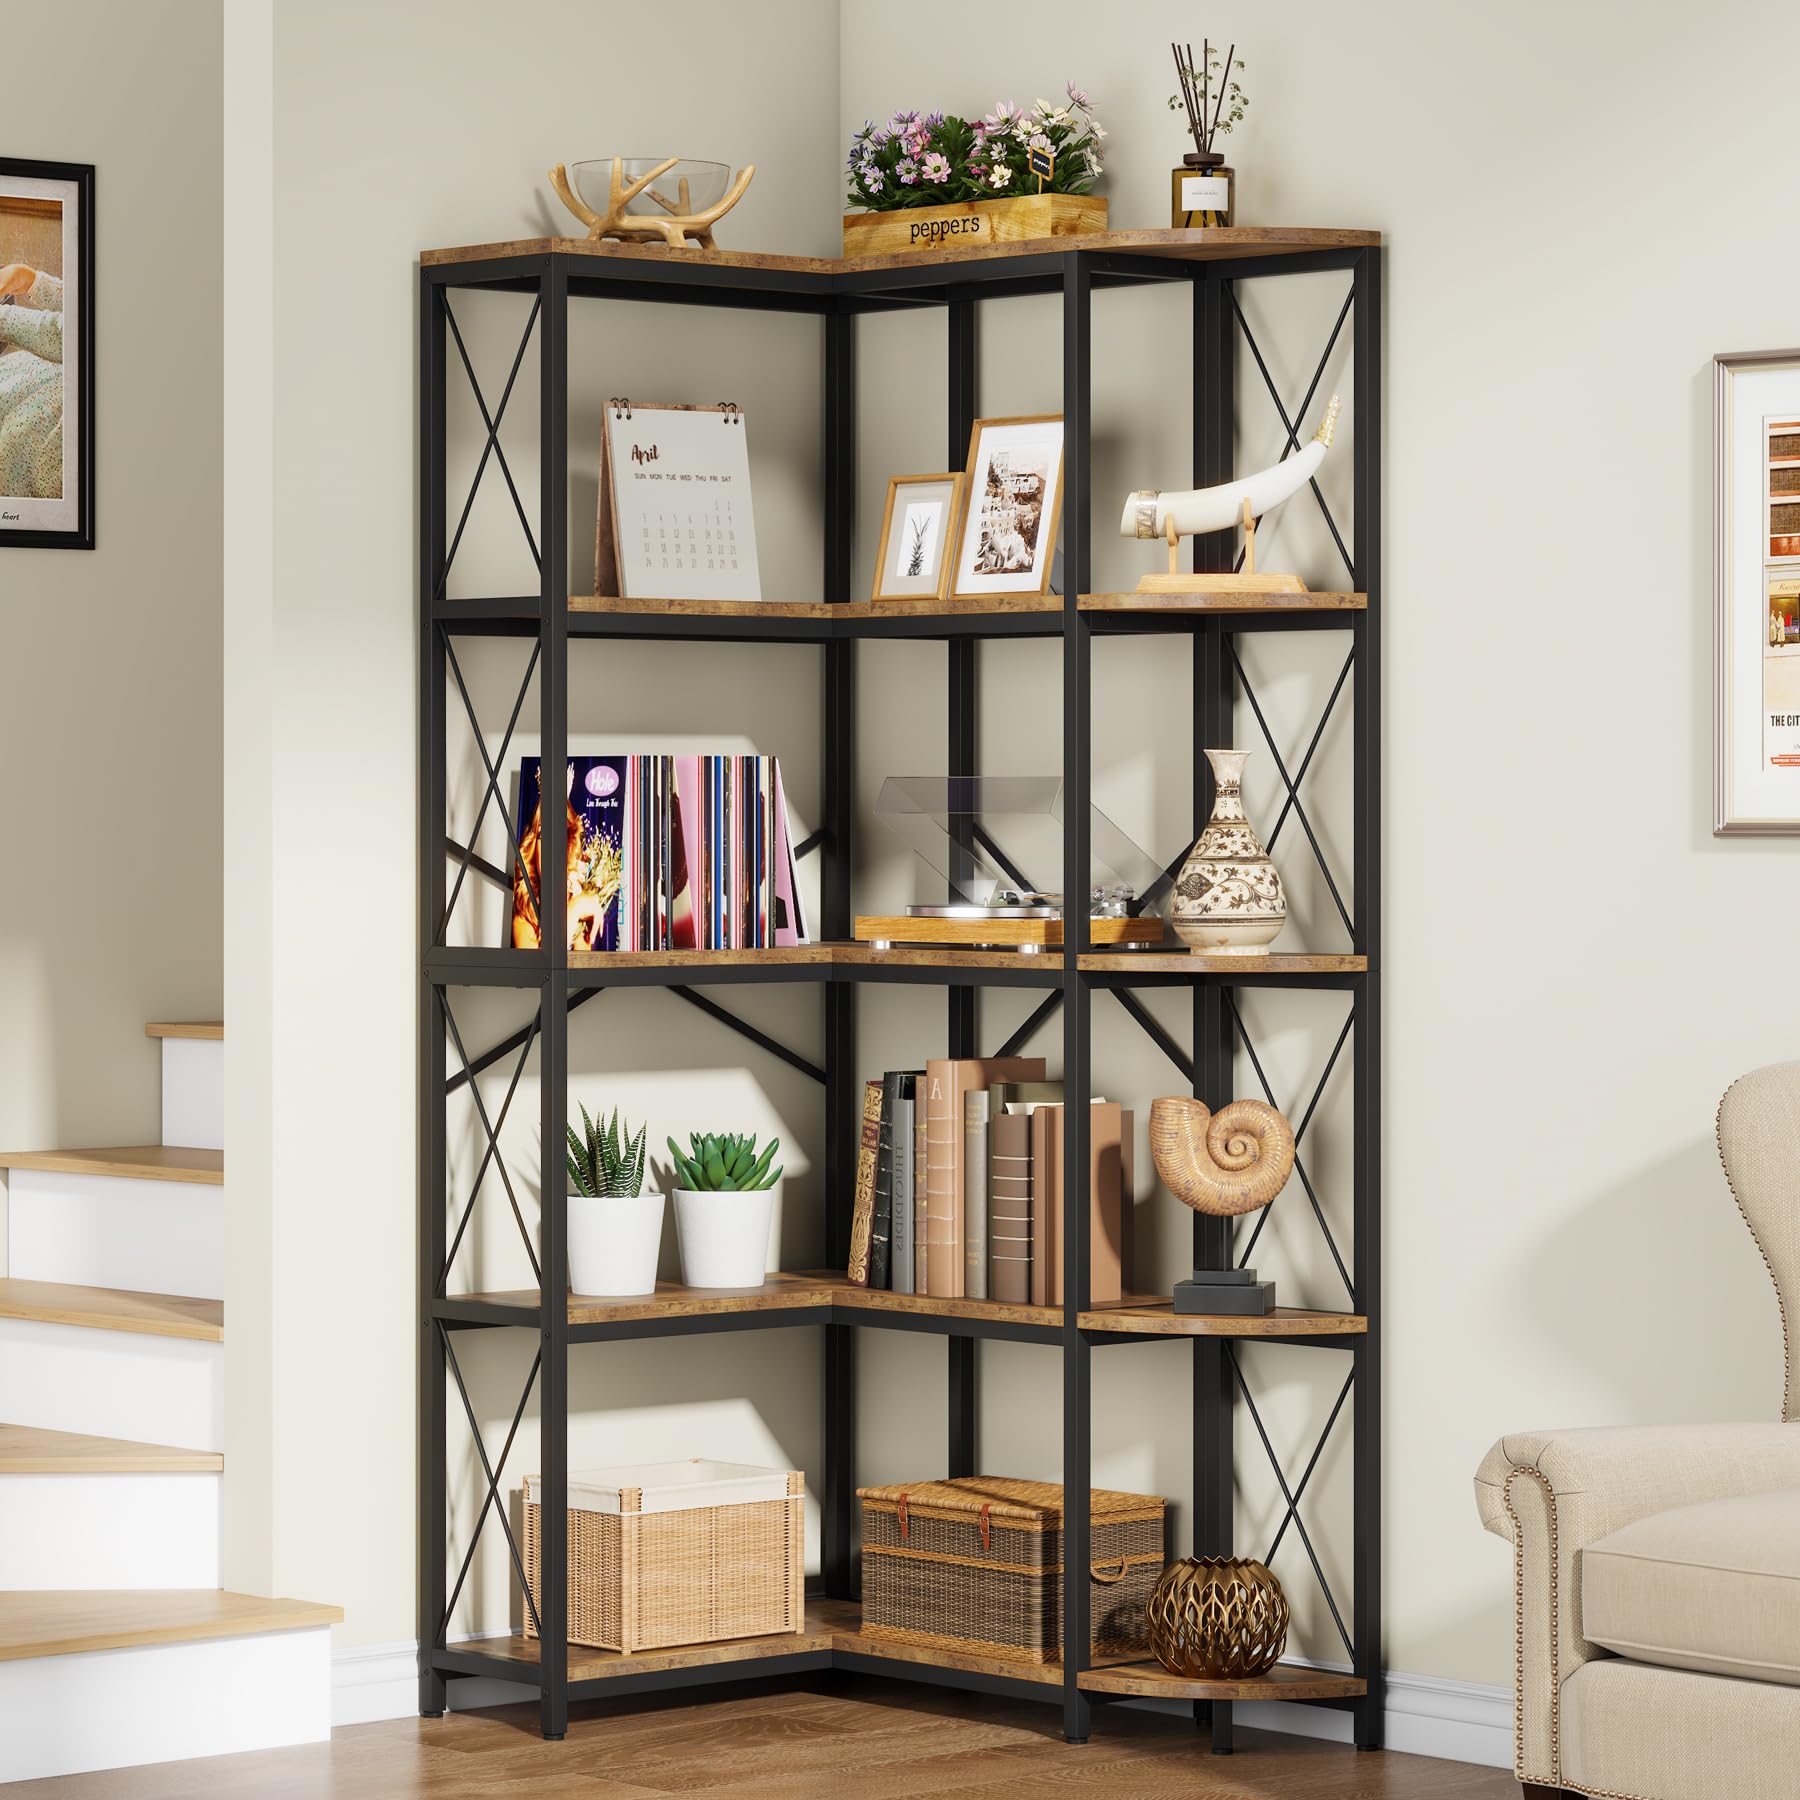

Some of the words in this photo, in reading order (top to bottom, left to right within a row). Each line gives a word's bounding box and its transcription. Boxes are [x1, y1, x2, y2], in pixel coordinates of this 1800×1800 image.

[910, 217, 980, 244] peppers
[631, 444, 659, 466] April
[1770, 715, 1785, 727] THE
[1786, 715, 1800, 727] CIT
[590, 769, 615, 792] Hole
